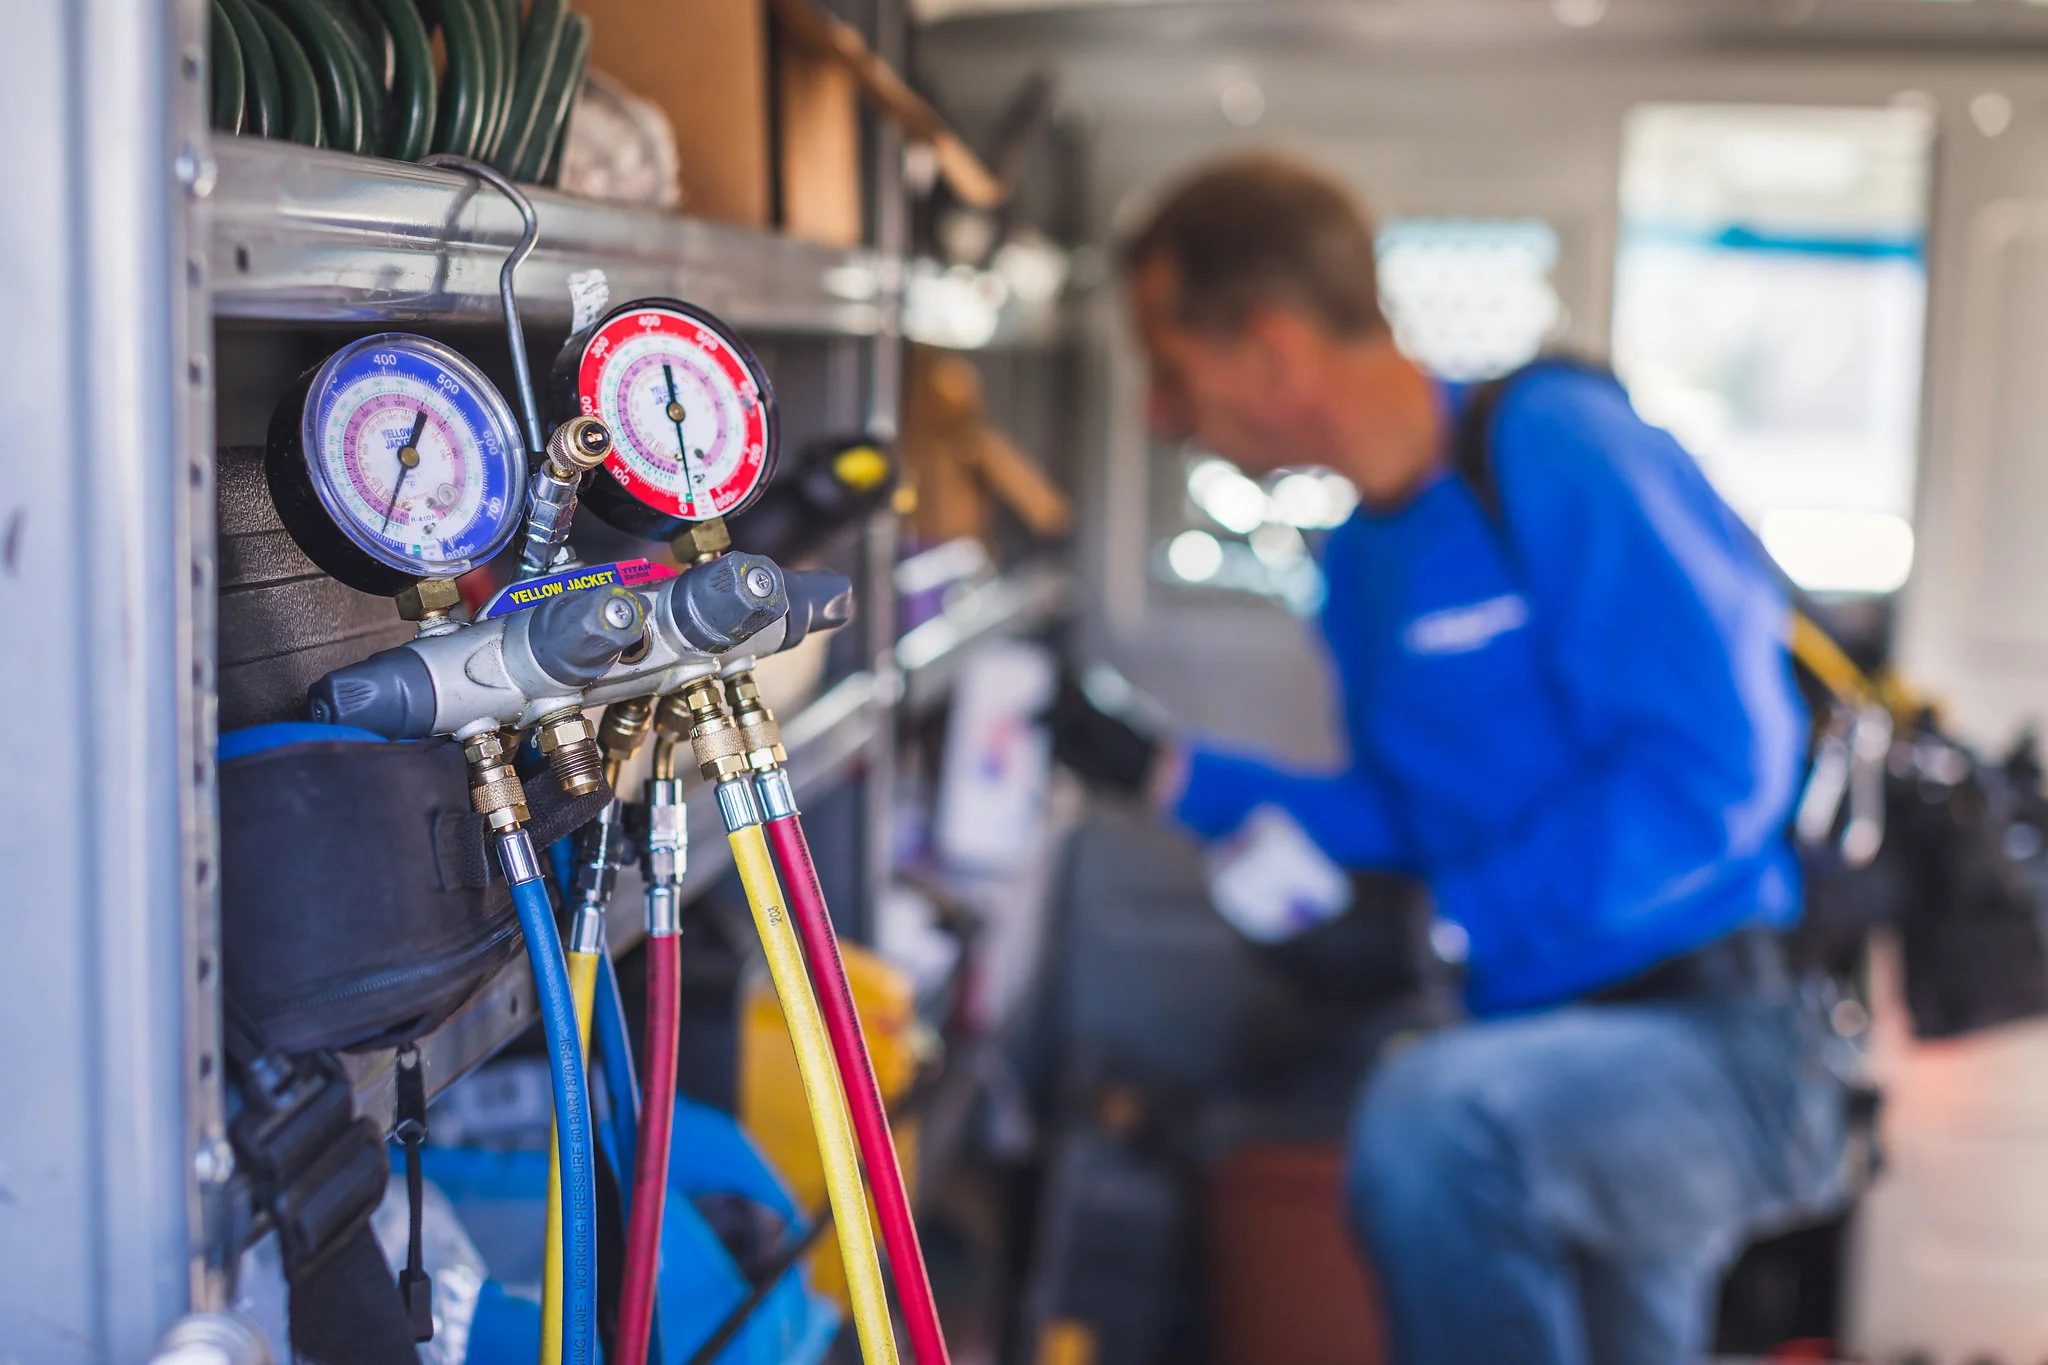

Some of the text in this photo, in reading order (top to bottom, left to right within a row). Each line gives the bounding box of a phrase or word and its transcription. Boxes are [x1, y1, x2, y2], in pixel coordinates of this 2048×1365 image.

[373, 354, 397, 366] 400
[436, 373, 460, 395] 500
[581, 395, 593, 416] 00
[482, 430, 499, 455] 600
[611, 466, 630, 486] 100
[373, 498, 383, 507] 20
[486, 496, 501, 520] 700
[679, 502, 688, 515] 0
[411, 514, 437, 523] R-410A
[621, 564, 651, 575] TITAN
[508, 571, 614, 605] YELLOW JACKET
[789, 815, 810, 867] ARGING
[806, 870, 820, 897] LINE
[819, 909, 842, 968] WORKING
[837, 971, 861, 1037] PRESSURE
[560, 1038, 574, 1061] PSI
[563, 1064, 577, 1086] 870
[567, 1096, 582, 1124] BAR
[570, 1128, 583, 1143] 60
[572, 1147, 587, 1220] PRESSURE
[574, 1223, 588, 1291] WORKING
[574, 1303, 587, 1335] LINE
[574, 1338, 587, 1365] ING
